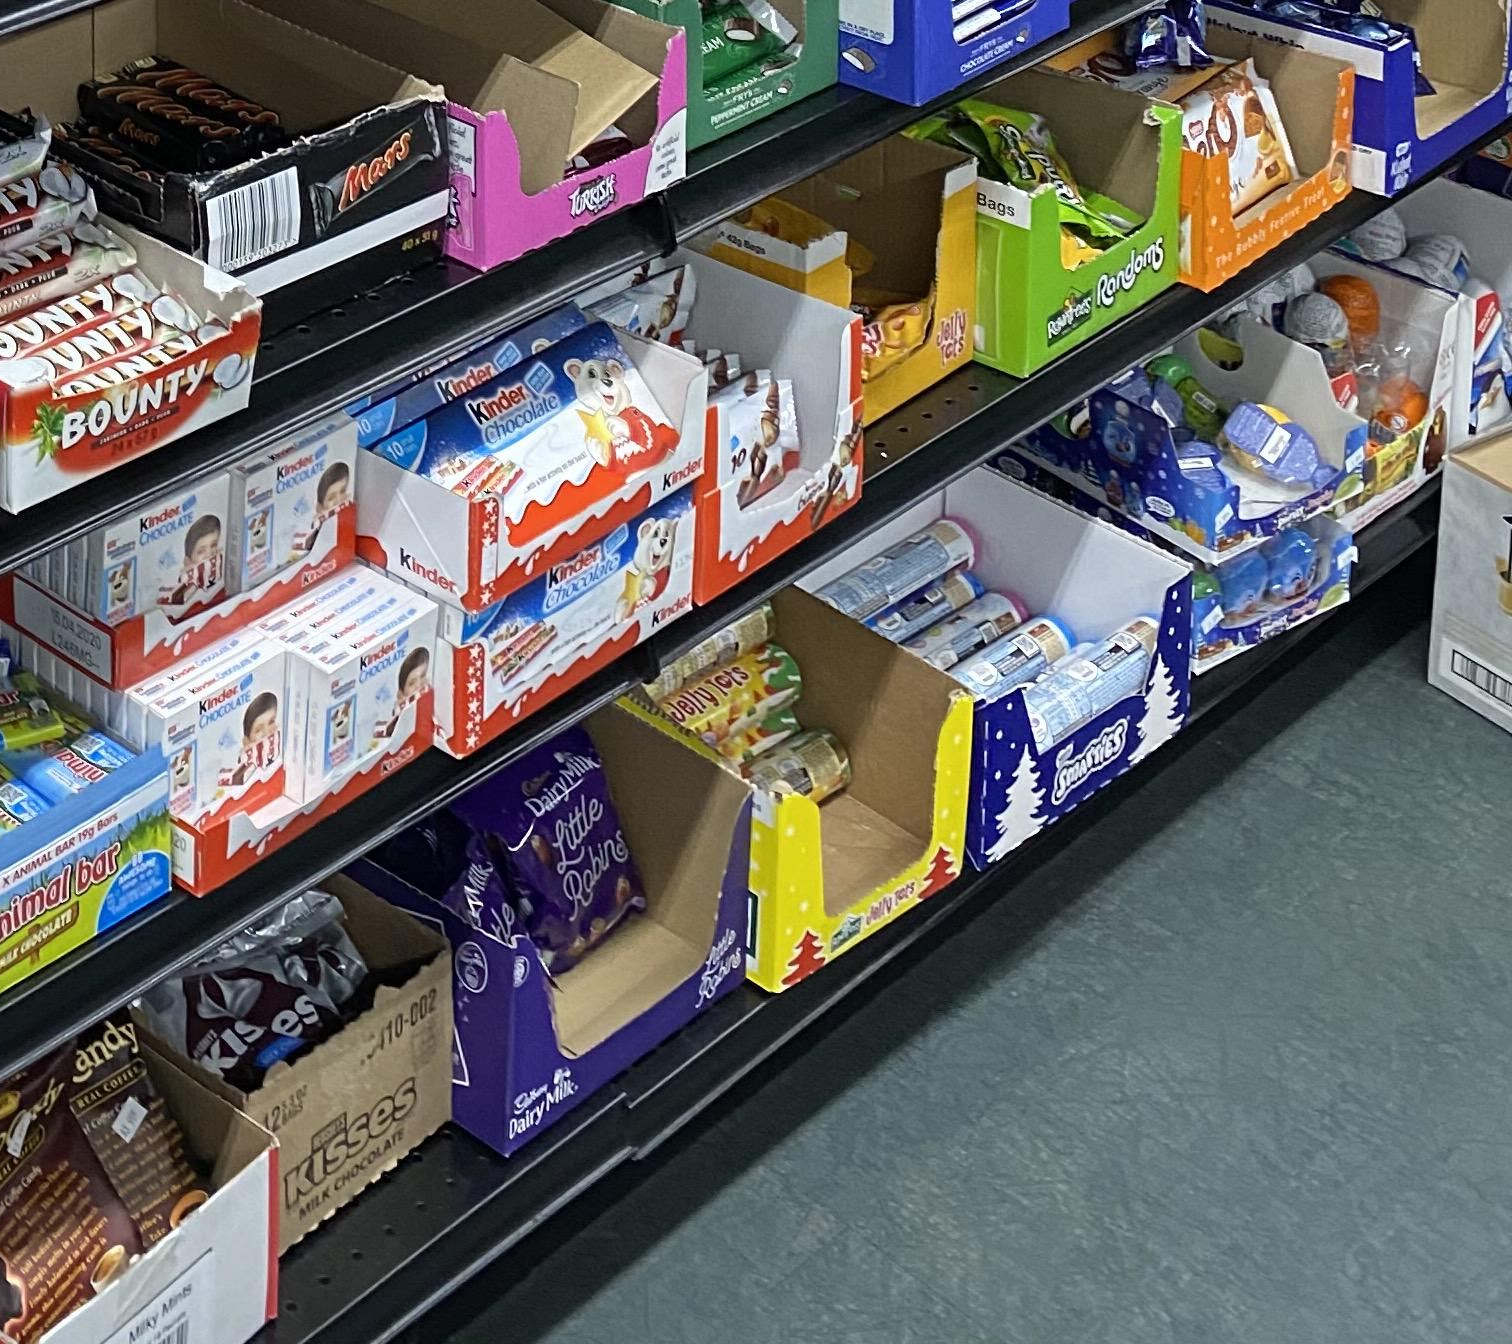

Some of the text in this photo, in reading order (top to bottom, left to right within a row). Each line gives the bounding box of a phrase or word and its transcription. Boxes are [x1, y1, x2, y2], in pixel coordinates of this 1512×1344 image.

[337, 130, 414, 212] Mars
[976, 192, 1016, 218] Bags
[1096, 236, 1165, 307] Randoms
[61, 359, 207, 449] BOUNTY
[468, 382, 527, 424] Kinder
[484, 392, 559, 445] Chocolate
[399, 547, 456, 593] Kinder
[2, 877, 11, 888] X
[12, 855, 52, 883] ANIMAL
[53, 842, 76, 862] BAR
[77, 828, 97, 849] 19g
[98, 812, 119, 831] Bars
[75, 841, 123, 899] bar
[296, 1130, 405, 1221] MILK CHOCOLATE
